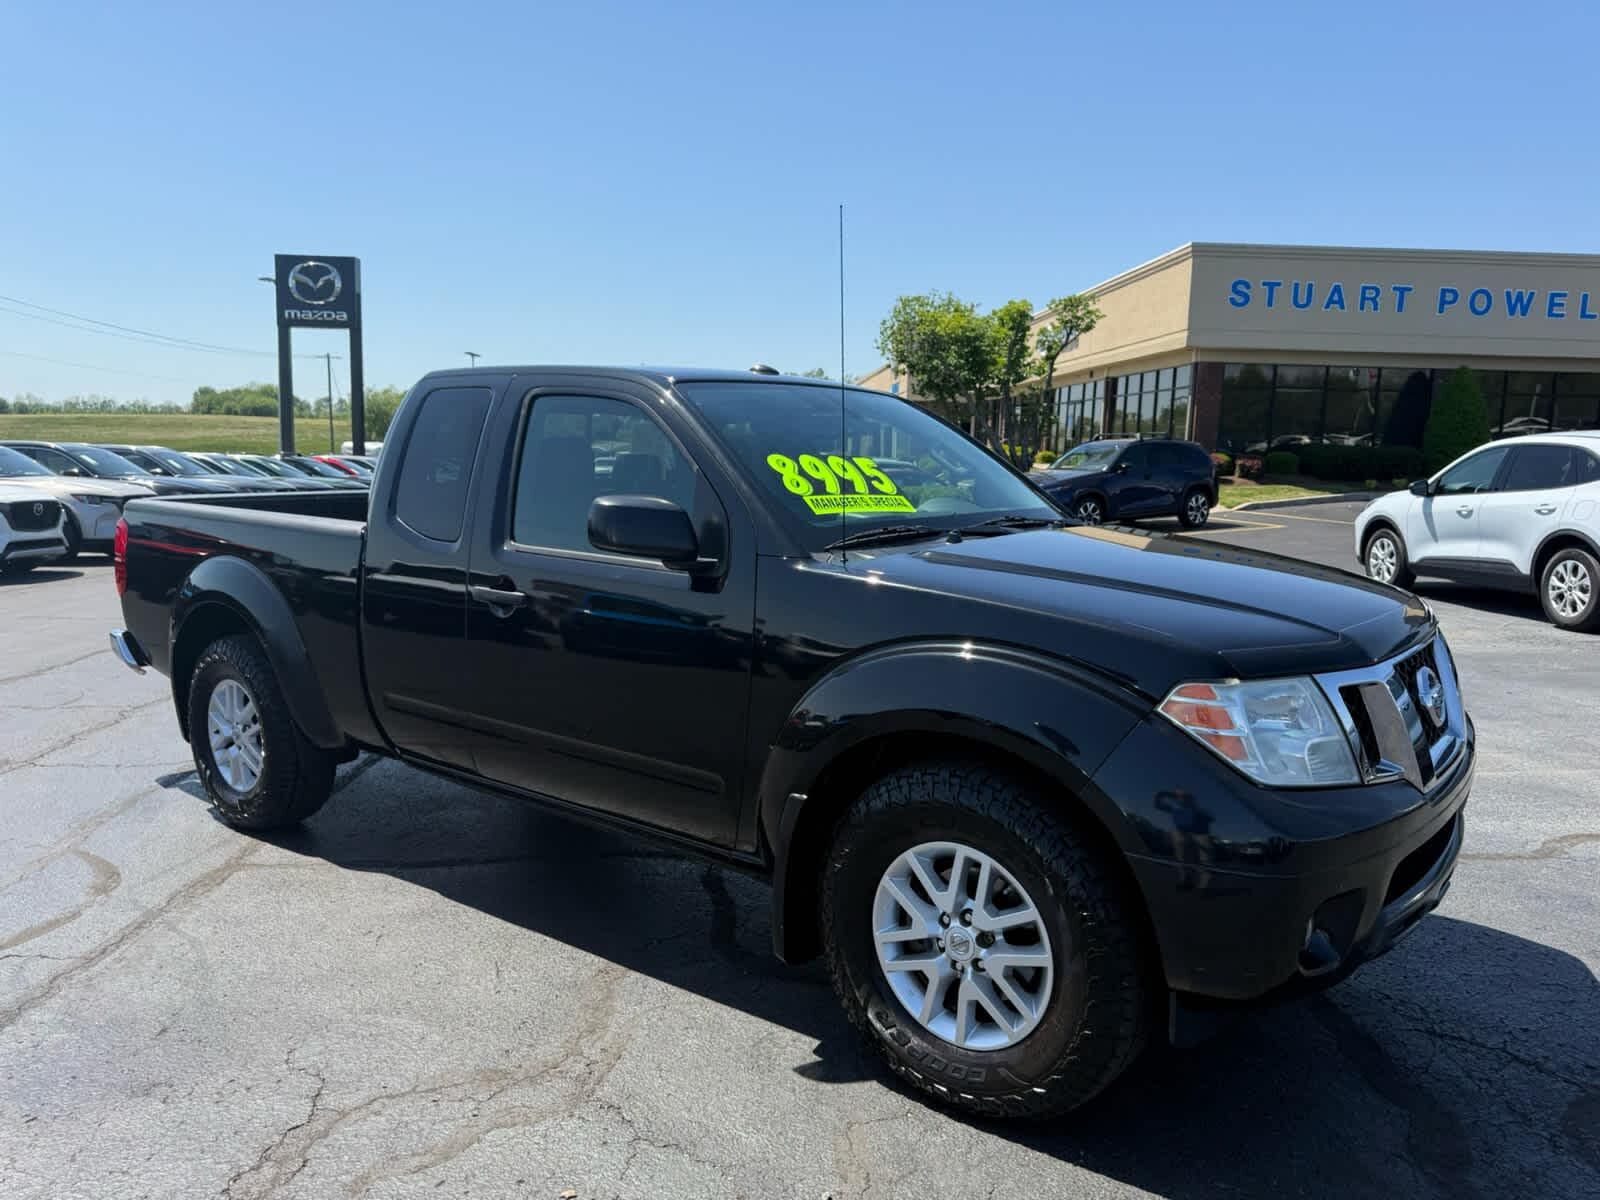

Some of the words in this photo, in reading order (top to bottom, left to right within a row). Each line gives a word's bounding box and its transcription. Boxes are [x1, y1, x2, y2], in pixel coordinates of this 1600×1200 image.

[1228, 279, 1414, 313] STUART
[1436, 286, 1599, 320] POWEL
[284, 309, 347, 321] mazda
[766, 453, 898, 496] 8995
[868, 496, 909, 508] SPECIAL
